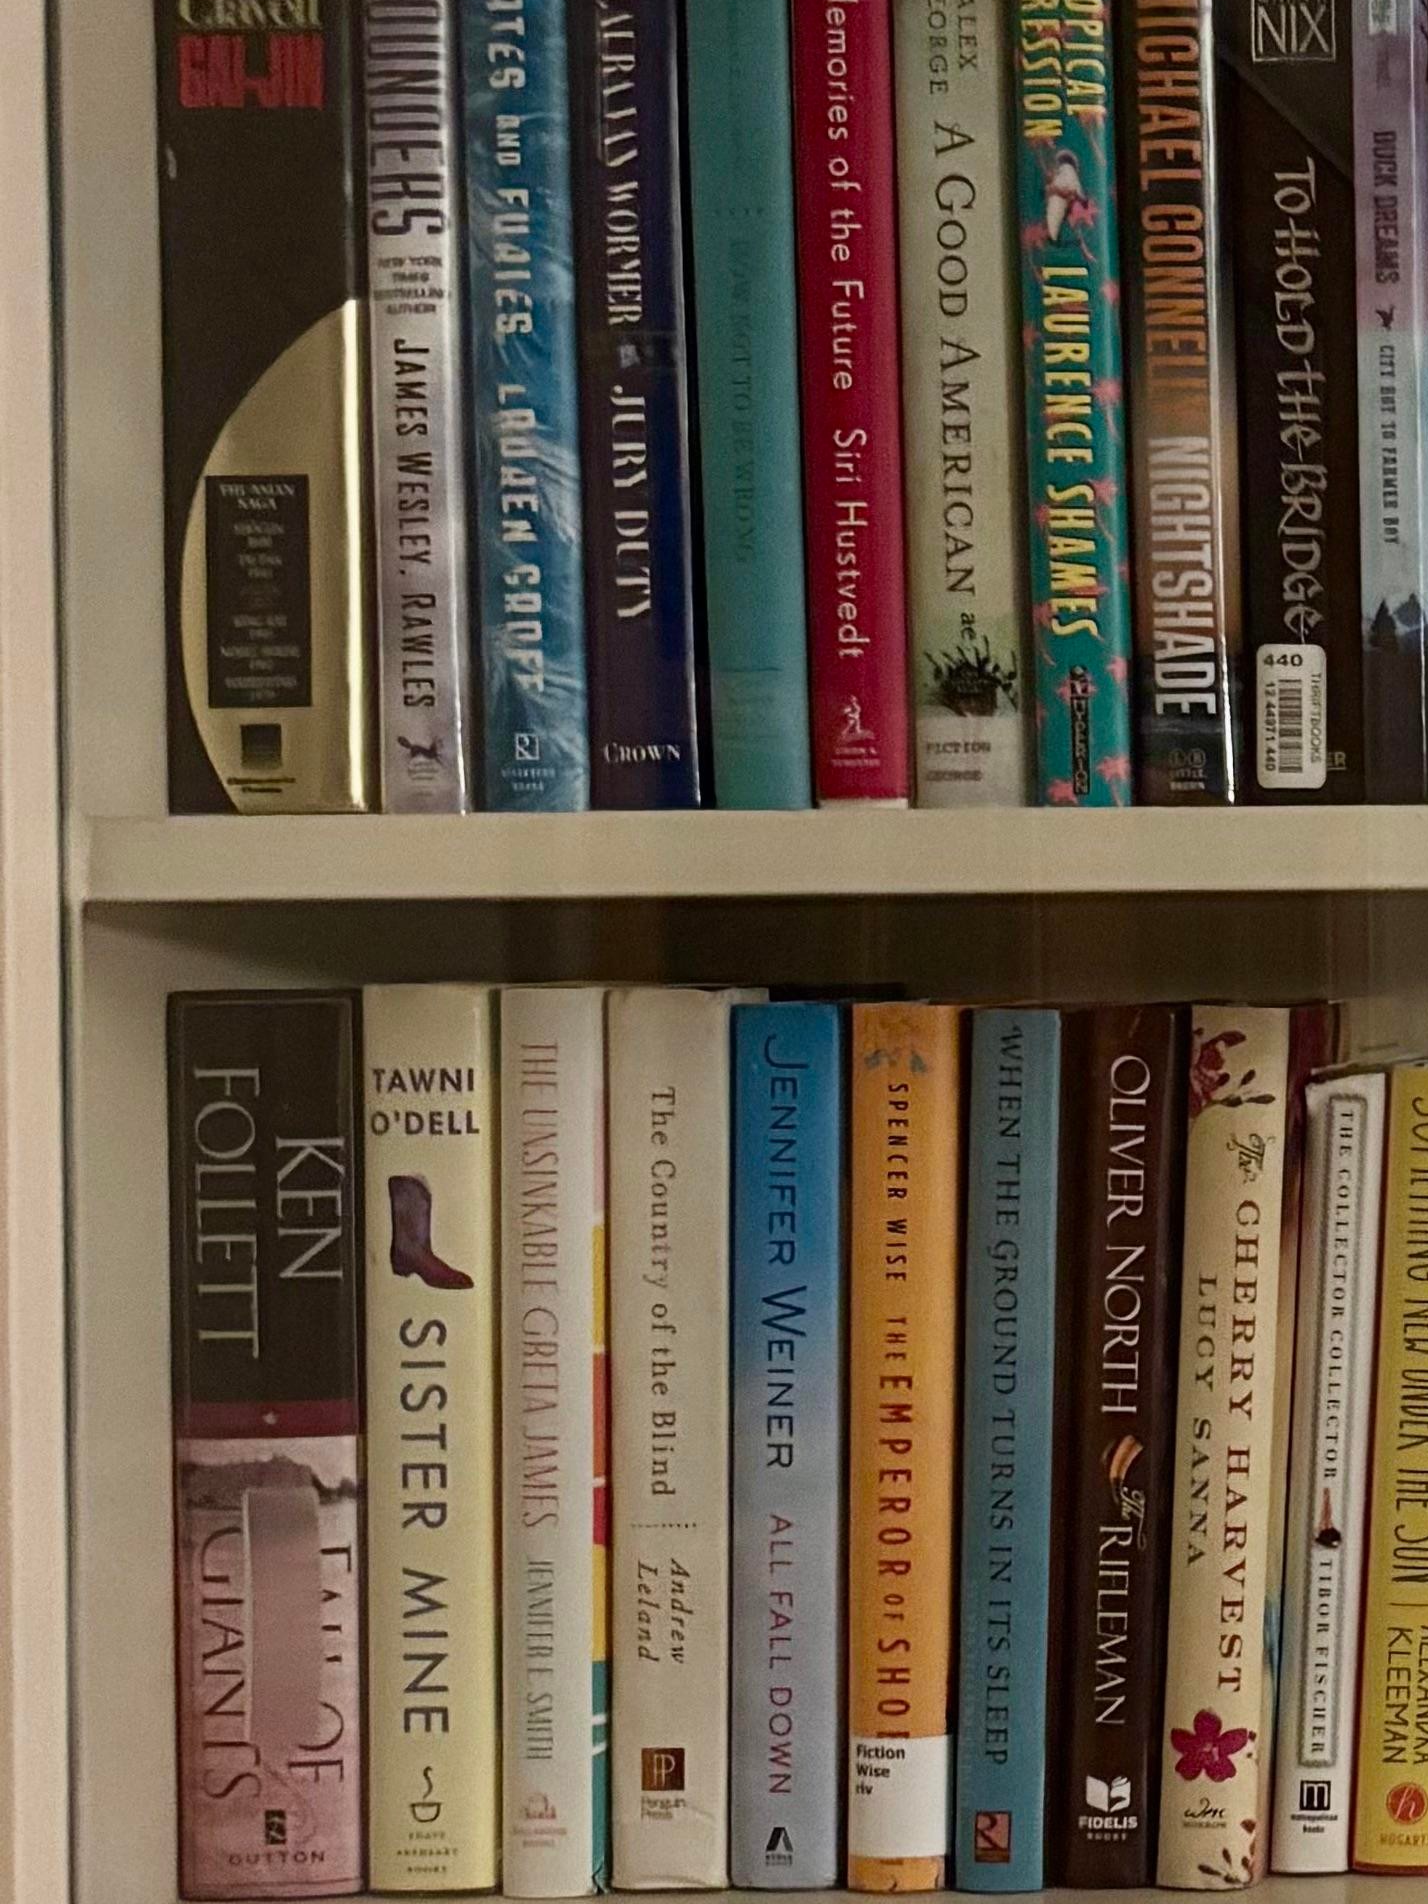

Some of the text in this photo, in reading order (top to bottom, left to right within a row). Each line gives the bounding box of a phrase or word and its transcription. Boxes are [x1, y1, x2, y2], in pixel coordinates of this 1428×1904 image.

[829, 156, 859, 194] of
[829, 207, 859, 263] the
[830, 277, 863, 392] Future
[932, 119, 981, 595] A GOOD AMERICAN
[831, 428, 870, 659] Siri Hustvedt
[1148, 434, 1218, 717] NIGHTSHADE
[1262, 652, 1304, 667] 440
[1308, 672, 1323, 764] THRIFTBOOKS
[370, 1110, 481, 1137] O'DELL
[371, 1066, 479, 1094] TAWNI
[194, 1062, 262, 1359] FOLLETT
[273, 1133, 346, 1284] KEN
[761, 1033, 813, 1470] JENNIFER WEINER
[1099, 1052, 1153, 1415] OLIVER NORTH
[398, 1315, 452, 1737] SISTER MINE
[1185, 1275, 1220, 1568] LUCY SANNA
[1214, 1195, 1264, 1696] CHERRY HARVEST
[767, 1513, 796, 1798] ALL FALL DOWN
[1092, 1522, 1136, 1729] RIFLEMAN
[1378, 1625, 1414, 1765] KLEEMAN
